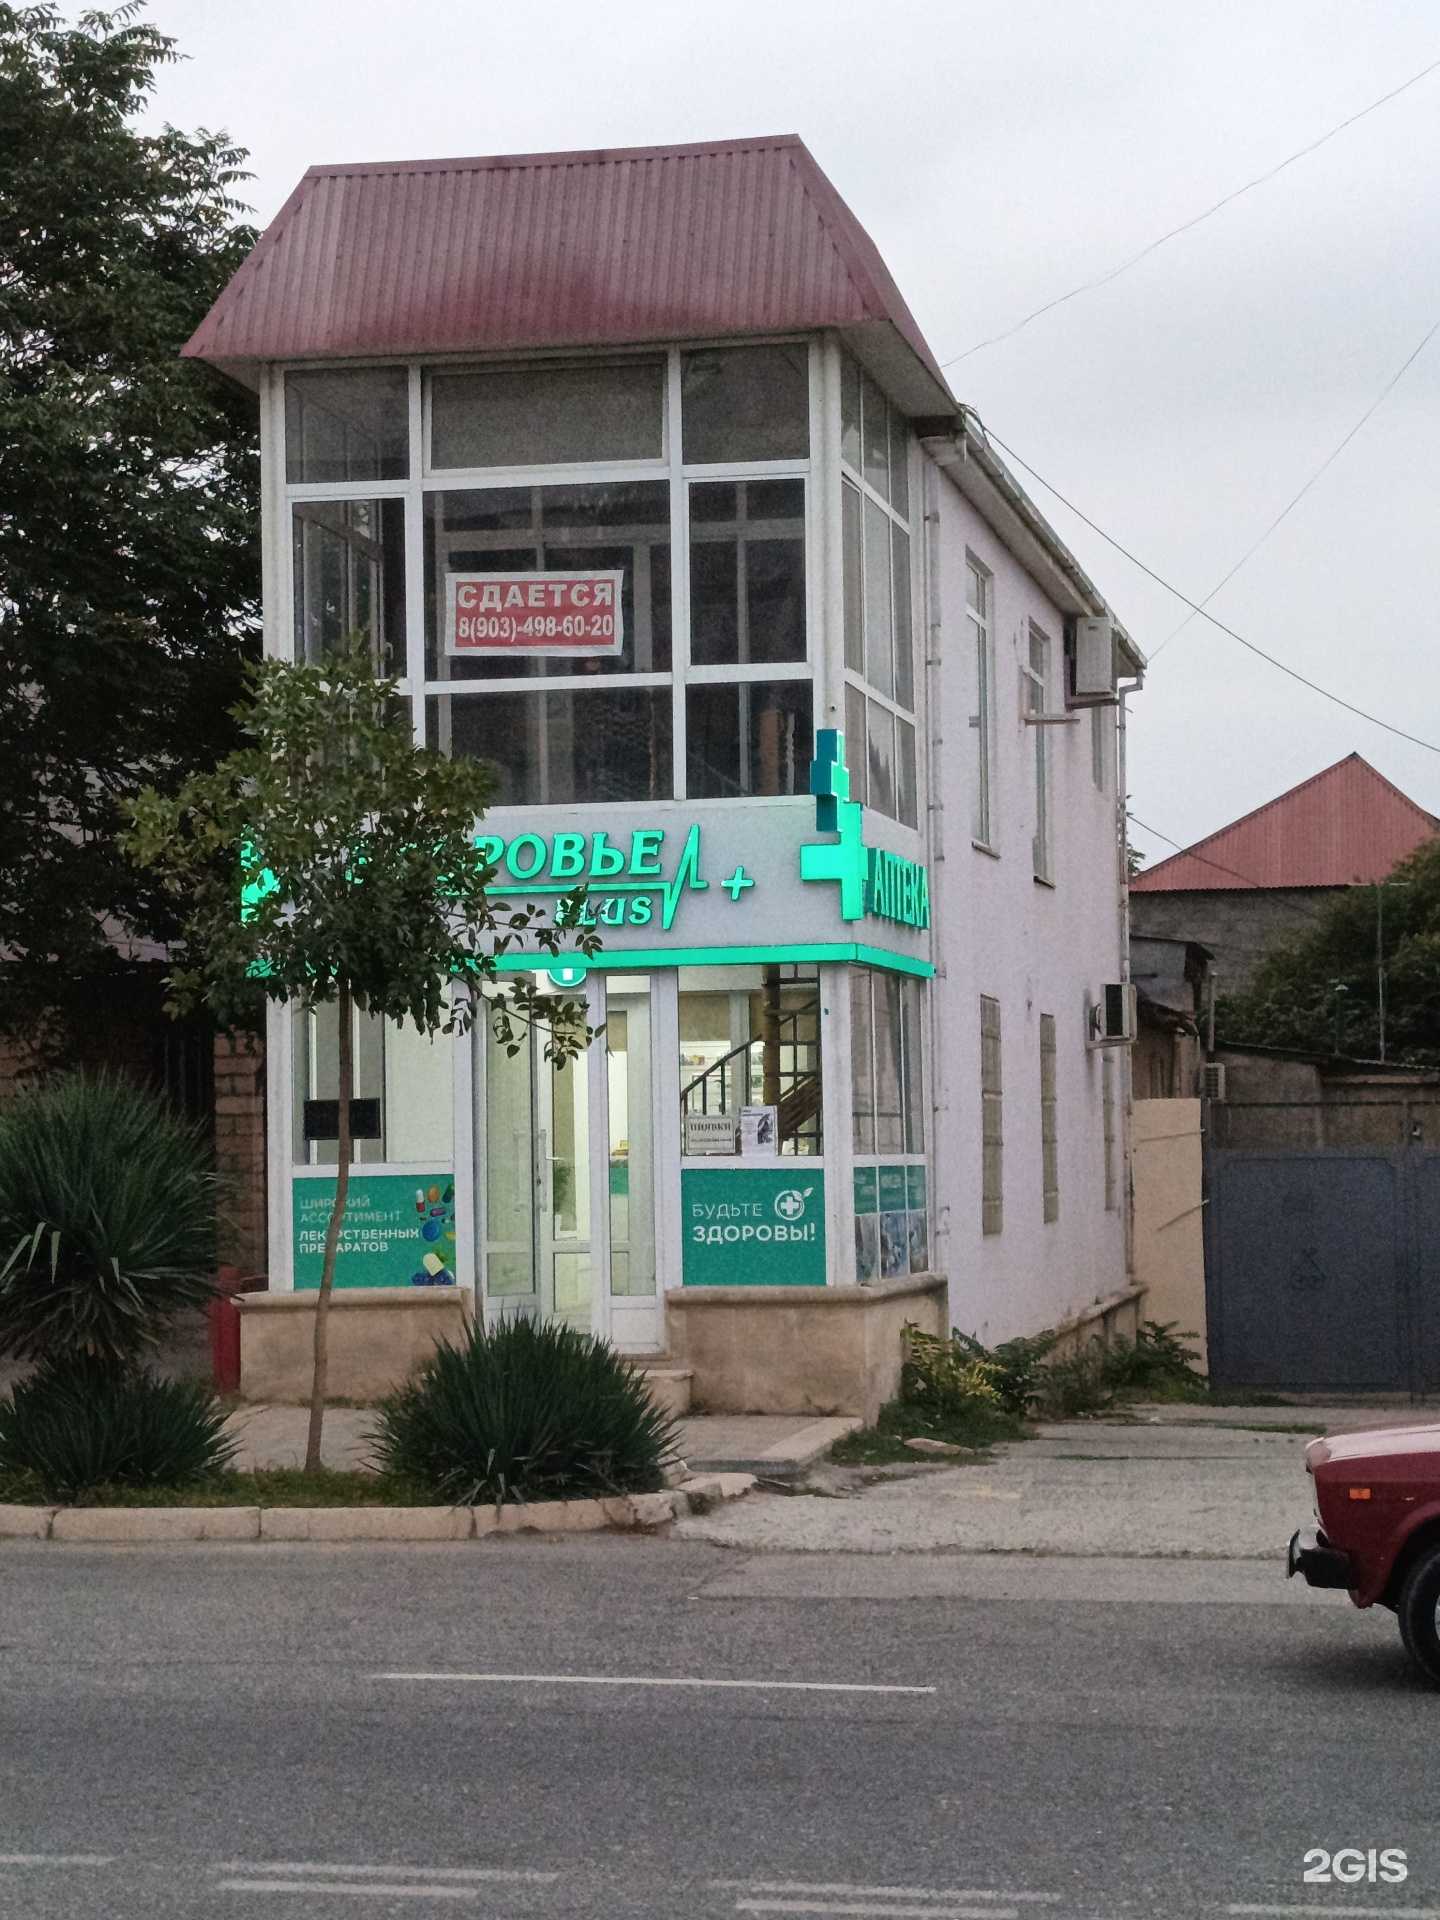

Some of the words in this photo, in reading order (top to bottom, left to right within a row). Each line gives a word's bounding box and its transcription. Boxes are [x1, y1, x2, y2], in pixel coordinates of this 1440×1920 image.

[457, 582, 613, 613] СДАЕТСЯ
[458, 614, 614, 643] 8(903)-498-60-20
[344, 829, 664, 884] РОВЬЕ
[873, 848, 931, 930] АПТЕКА
[300, 1210, 402, 1223] АССТИМЕНТ
[692, 1203, 762, 1220] БУДЬТЕ
[299, 1228, 420, 1242] ЛЕКСТВЕННЫХ
[693, 1222, 816, 1245] ЗДОРОВЫ!
[299, 1242, 389, 1254] ПРЕАРАТОВ
